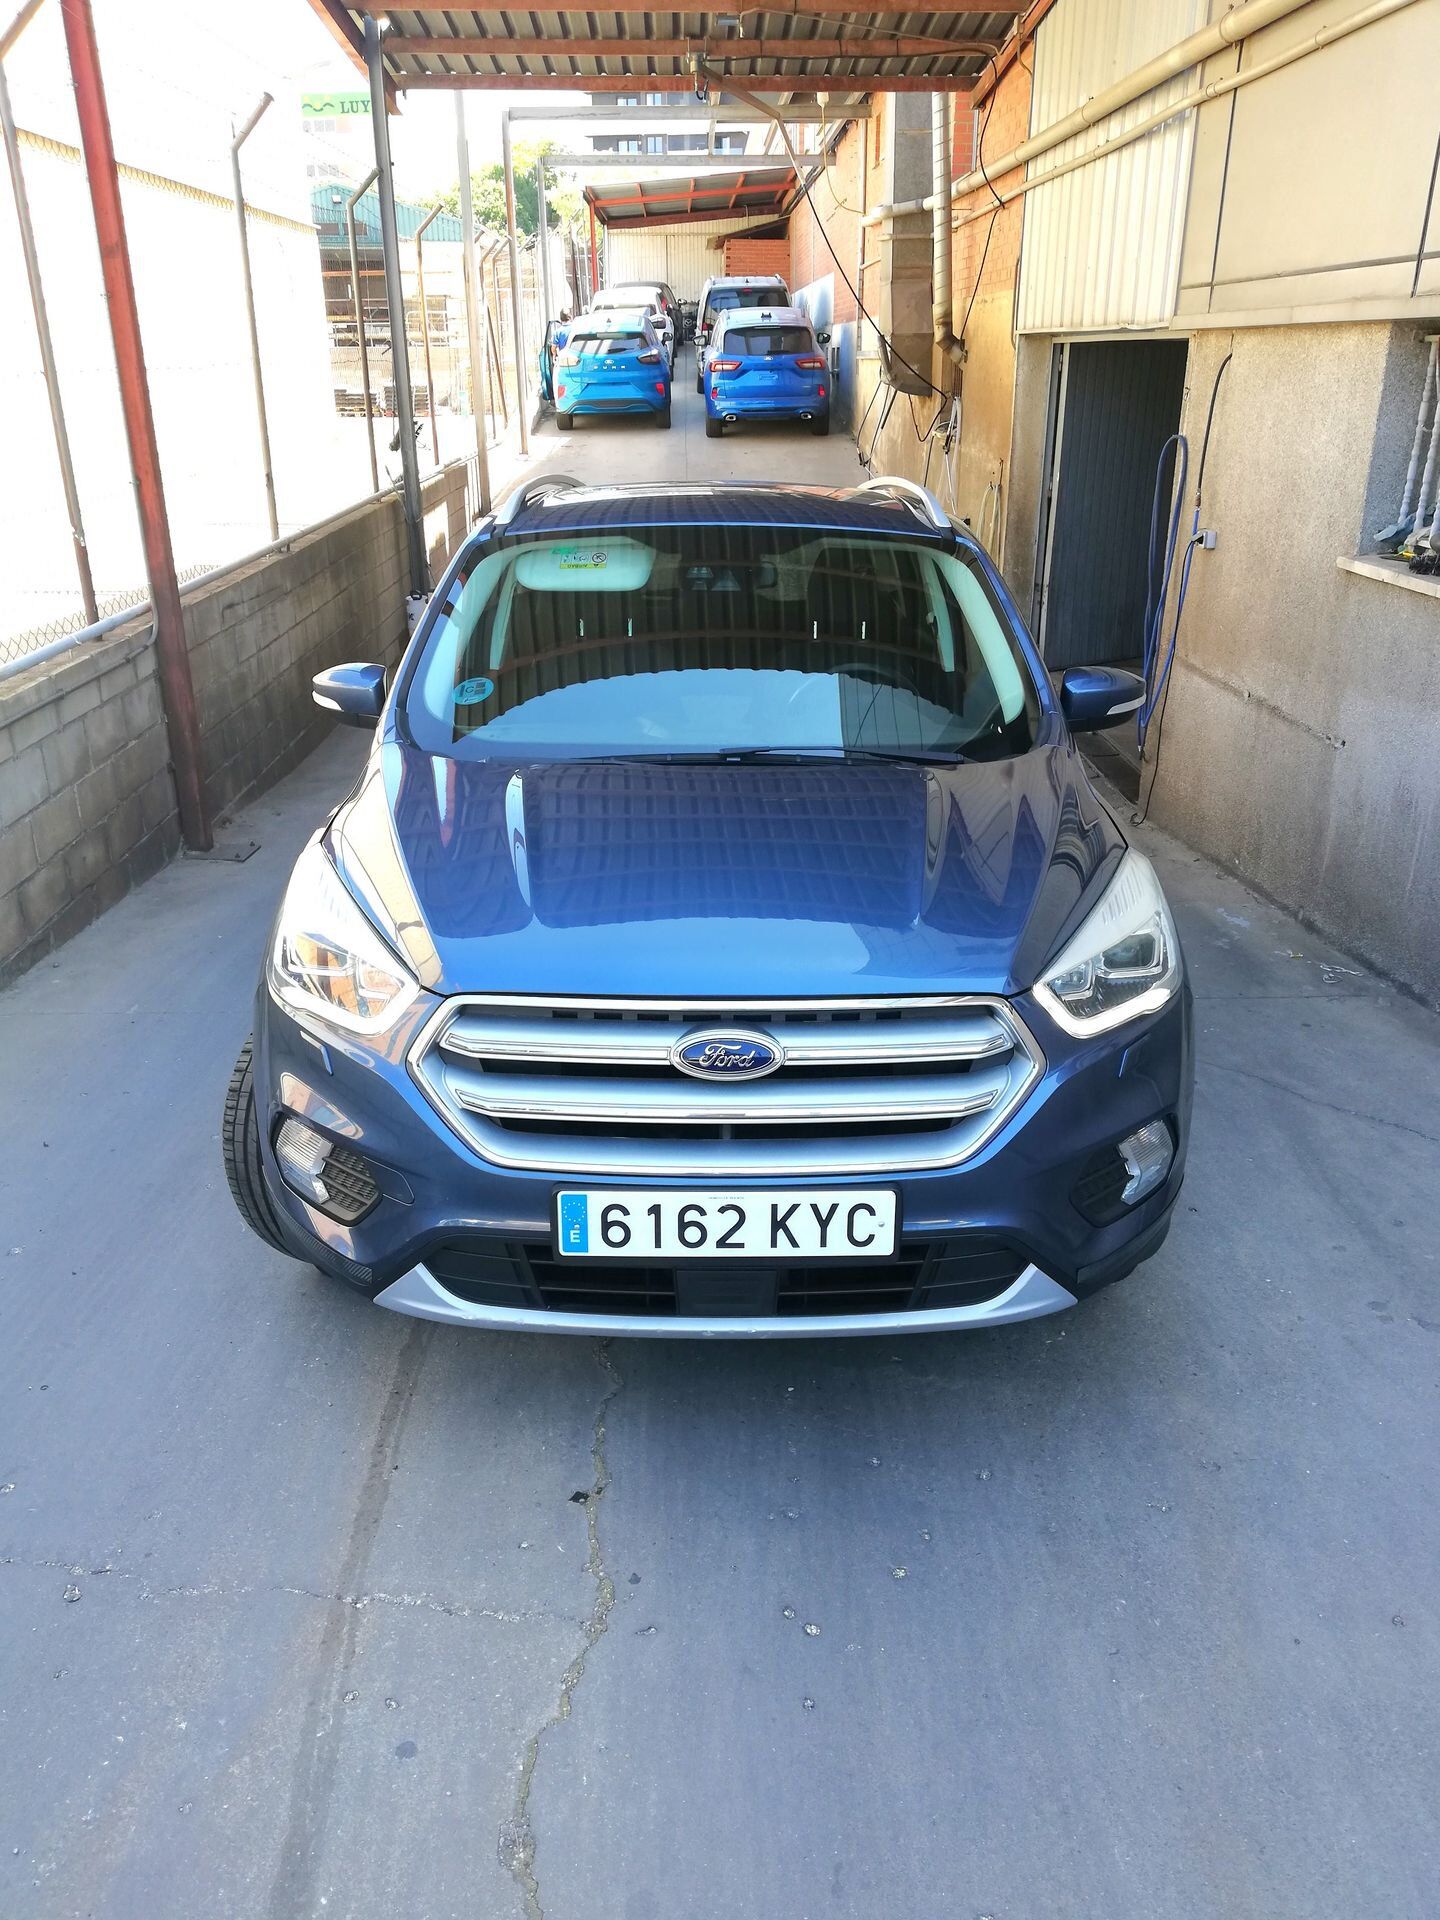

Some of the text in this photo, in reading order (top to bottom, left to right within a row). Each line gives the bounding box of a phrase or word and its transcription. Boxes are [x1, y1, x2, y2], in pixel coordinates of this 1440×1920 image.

[699, 1043, 756, 1067] Ford
[570, 1230, 580, 1243] E
[600, 1203, 877, 1250] 6162 KYC
